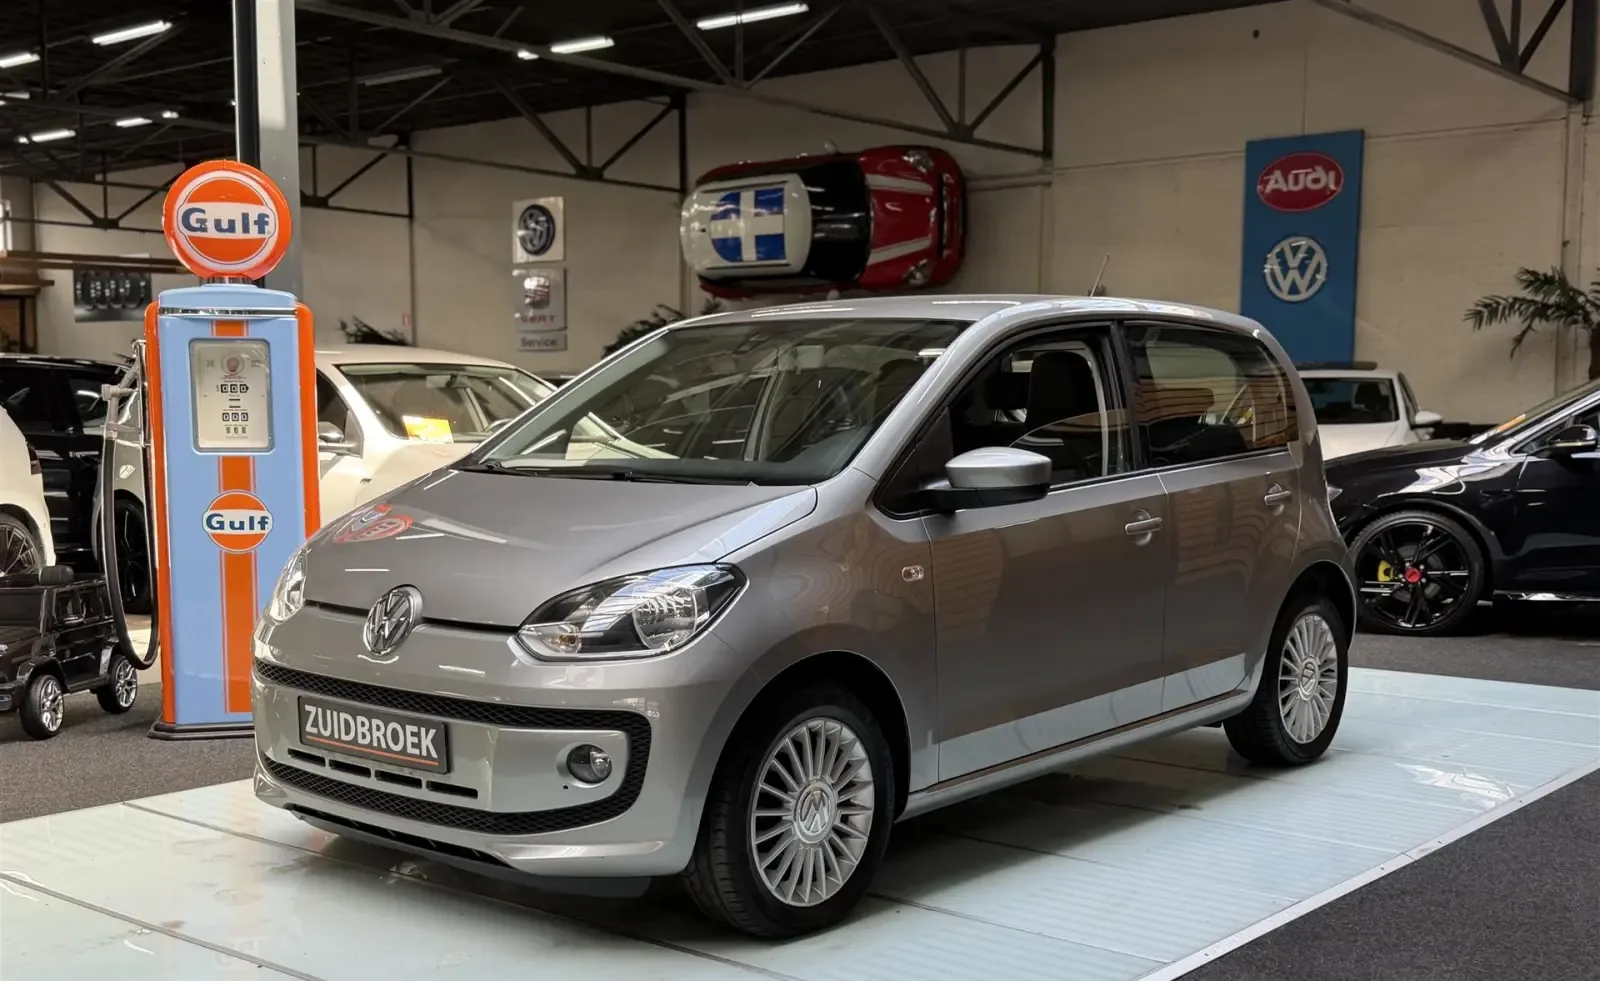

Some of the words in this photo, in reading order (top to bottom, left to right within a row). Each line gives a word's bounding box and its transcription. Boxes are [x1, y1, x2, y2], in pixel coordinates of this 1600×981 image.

[181, 207, 270, 235] Gulf
[520, 336, 558, 348] Service
[205, 513, 270, 531] Gulf
[304, 704, 438, 759] ZUIDBROEK
